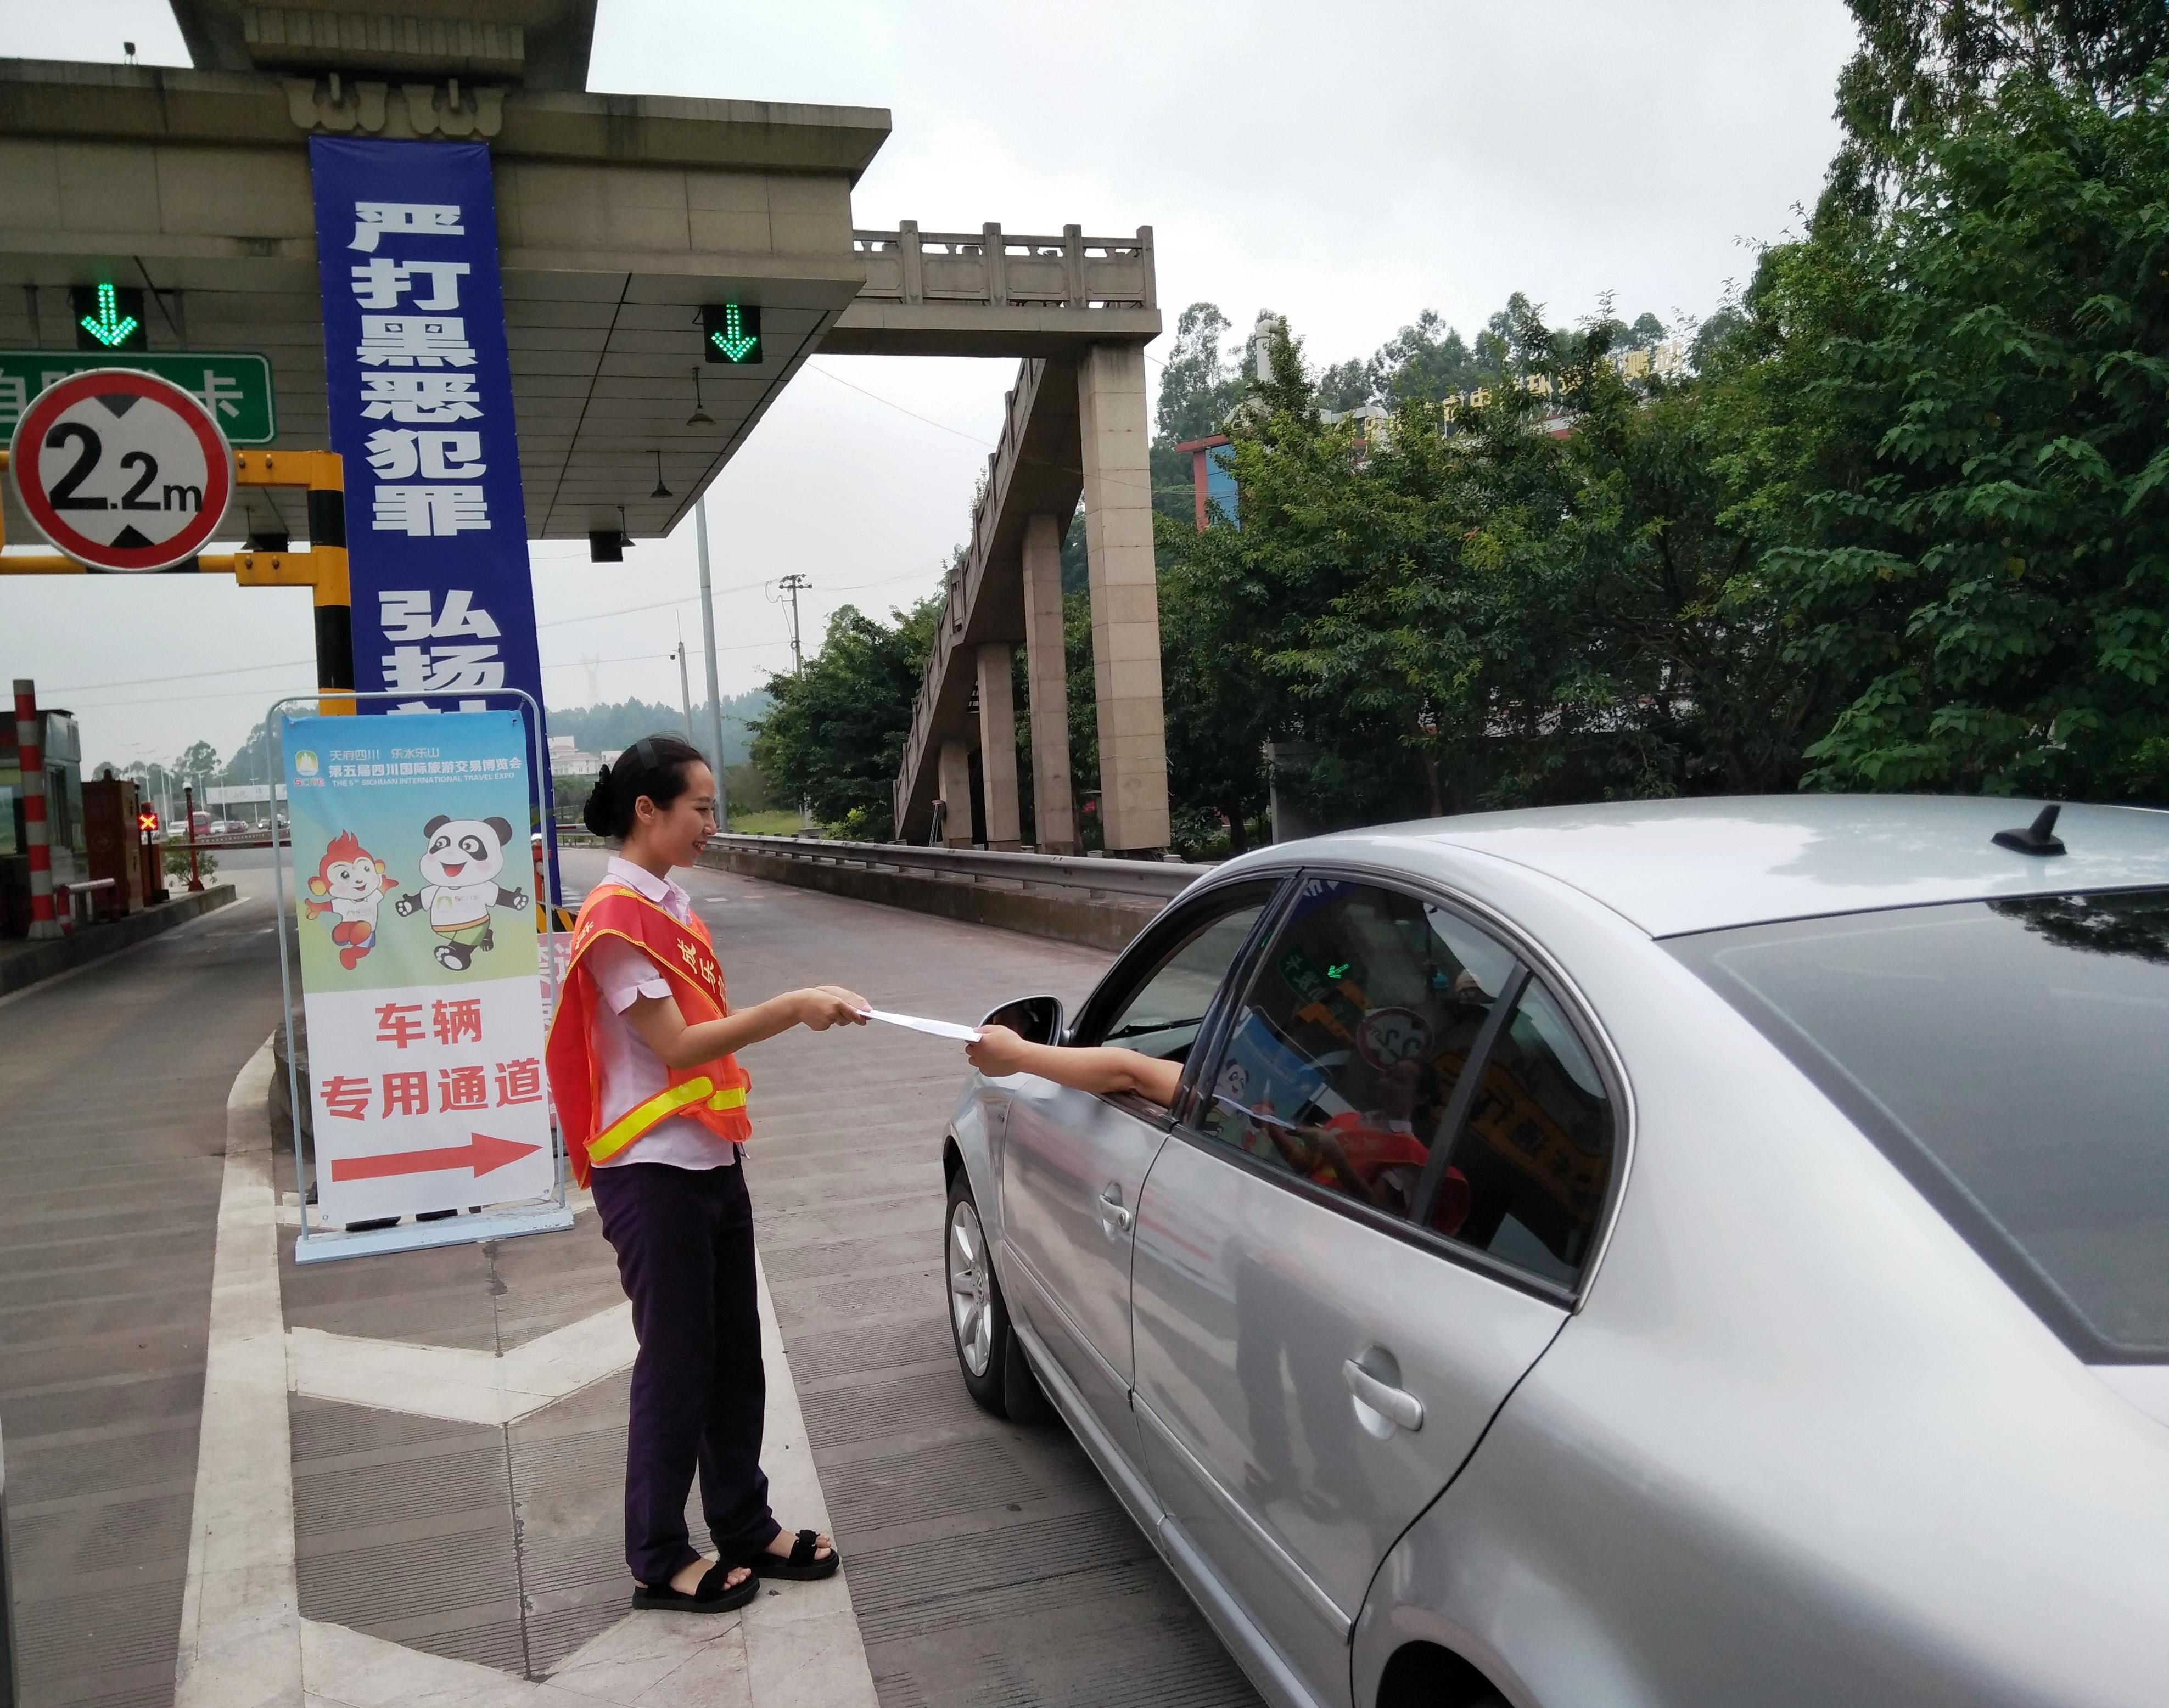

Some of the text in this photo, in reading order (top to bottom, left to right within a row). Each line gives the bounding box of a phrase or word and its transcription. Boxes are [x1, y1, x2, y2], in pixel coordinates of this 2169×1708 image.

[46, 422, 203, 512] 2.2m
[346, 201, 506, 715] 严打黑恶犯罪 弘扬
[329, 757, 522, 778] 第五届四川国际旅游交易博览会
[330, 747, 439, 761] 天府四川 乐水乐山
[399, 776, 462, 784] INTERNATIONAL
[375, 999, 483, 1049] 车辆
[320, 1058, 543, 1121] 专用通道
